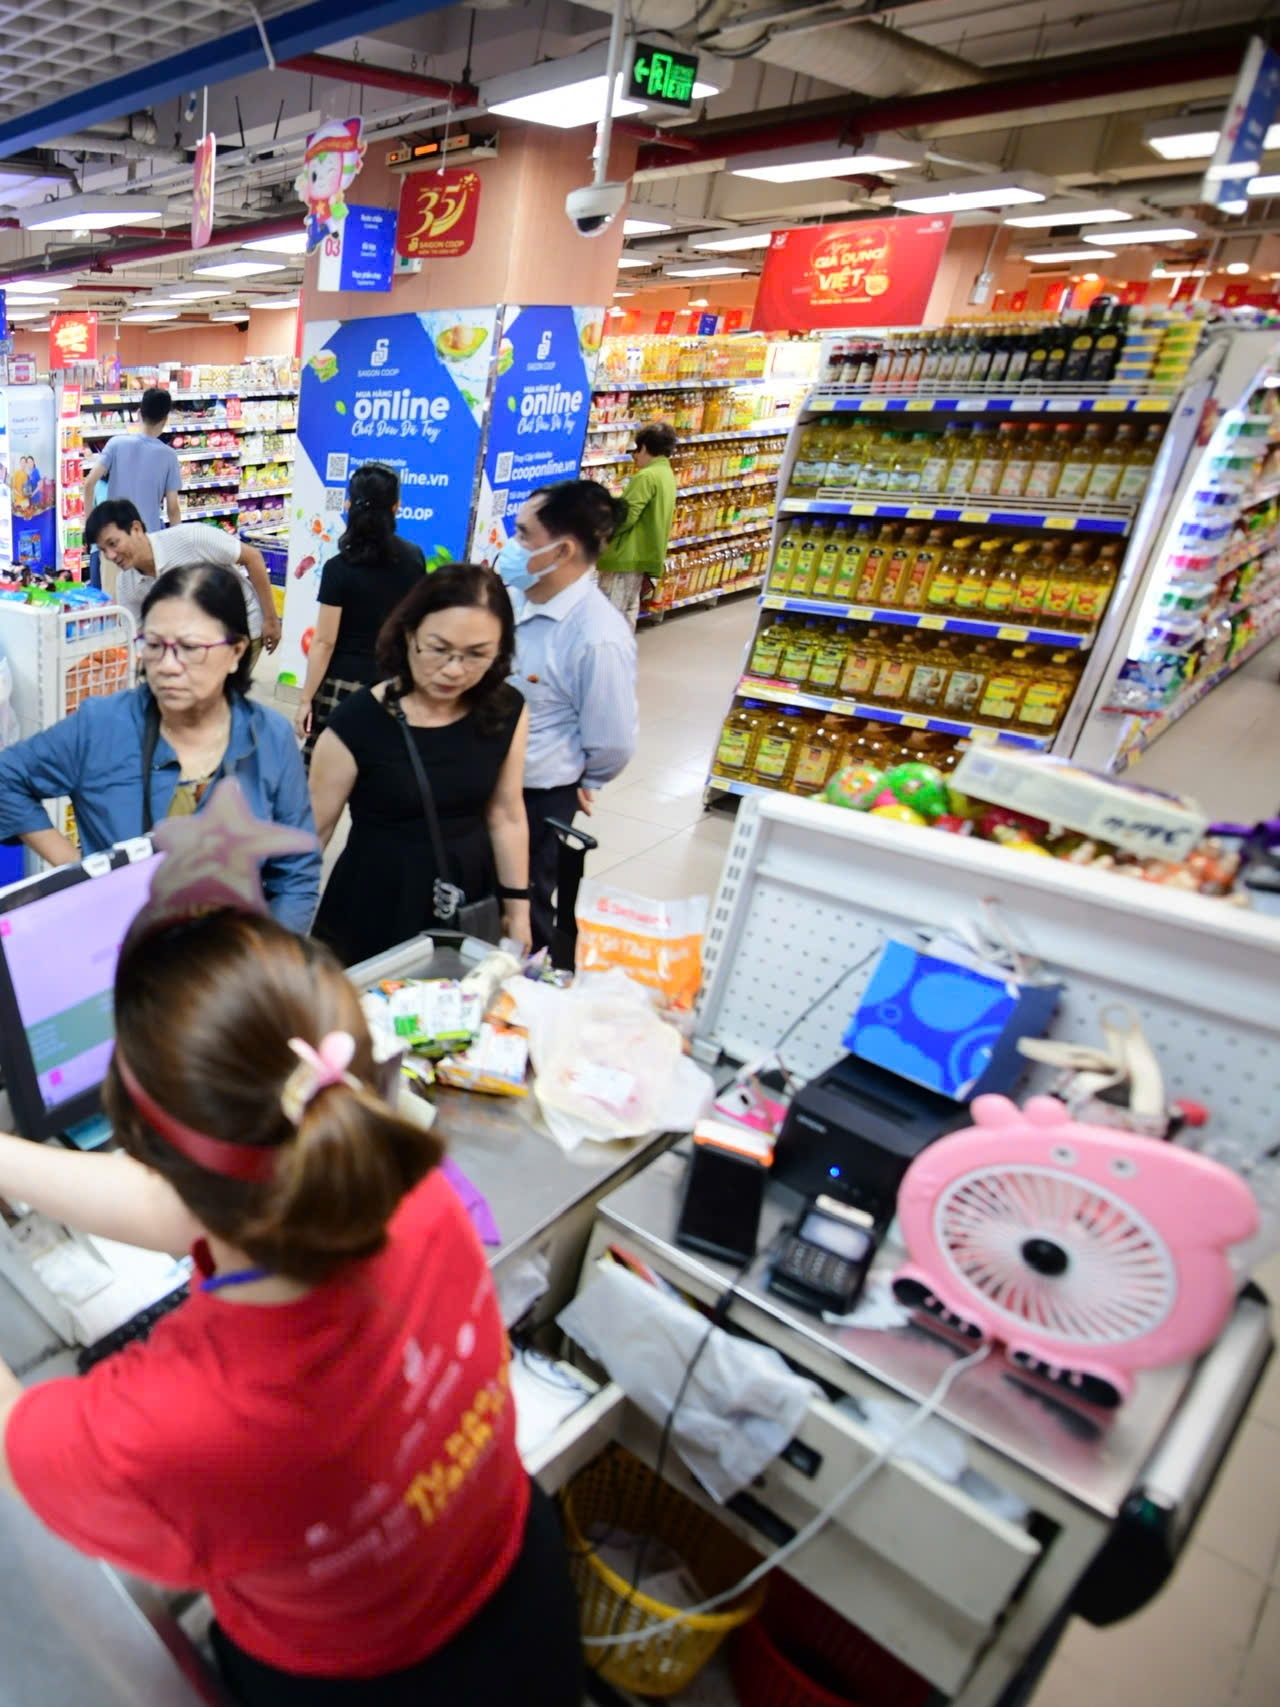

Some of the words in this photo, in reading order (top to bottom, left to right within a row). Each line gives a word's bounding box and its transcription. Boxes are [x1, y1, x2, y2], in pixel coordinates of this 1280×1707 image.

[405, 185, 467, 238] 35
[325, 238, 341, 257] 03
[815, 256, 838, 268] GIA
[819, 266, 865, 292] VIỆT
[357, 369, 380, 377] SAIGON
[381, 368, 400, 377] COOP
[353, 388, 451, 421] online
[355, 390, 372, 398] MUA
[520, 382, 583, 416] online
[511, 459, 577, 481] cooponline.vn
